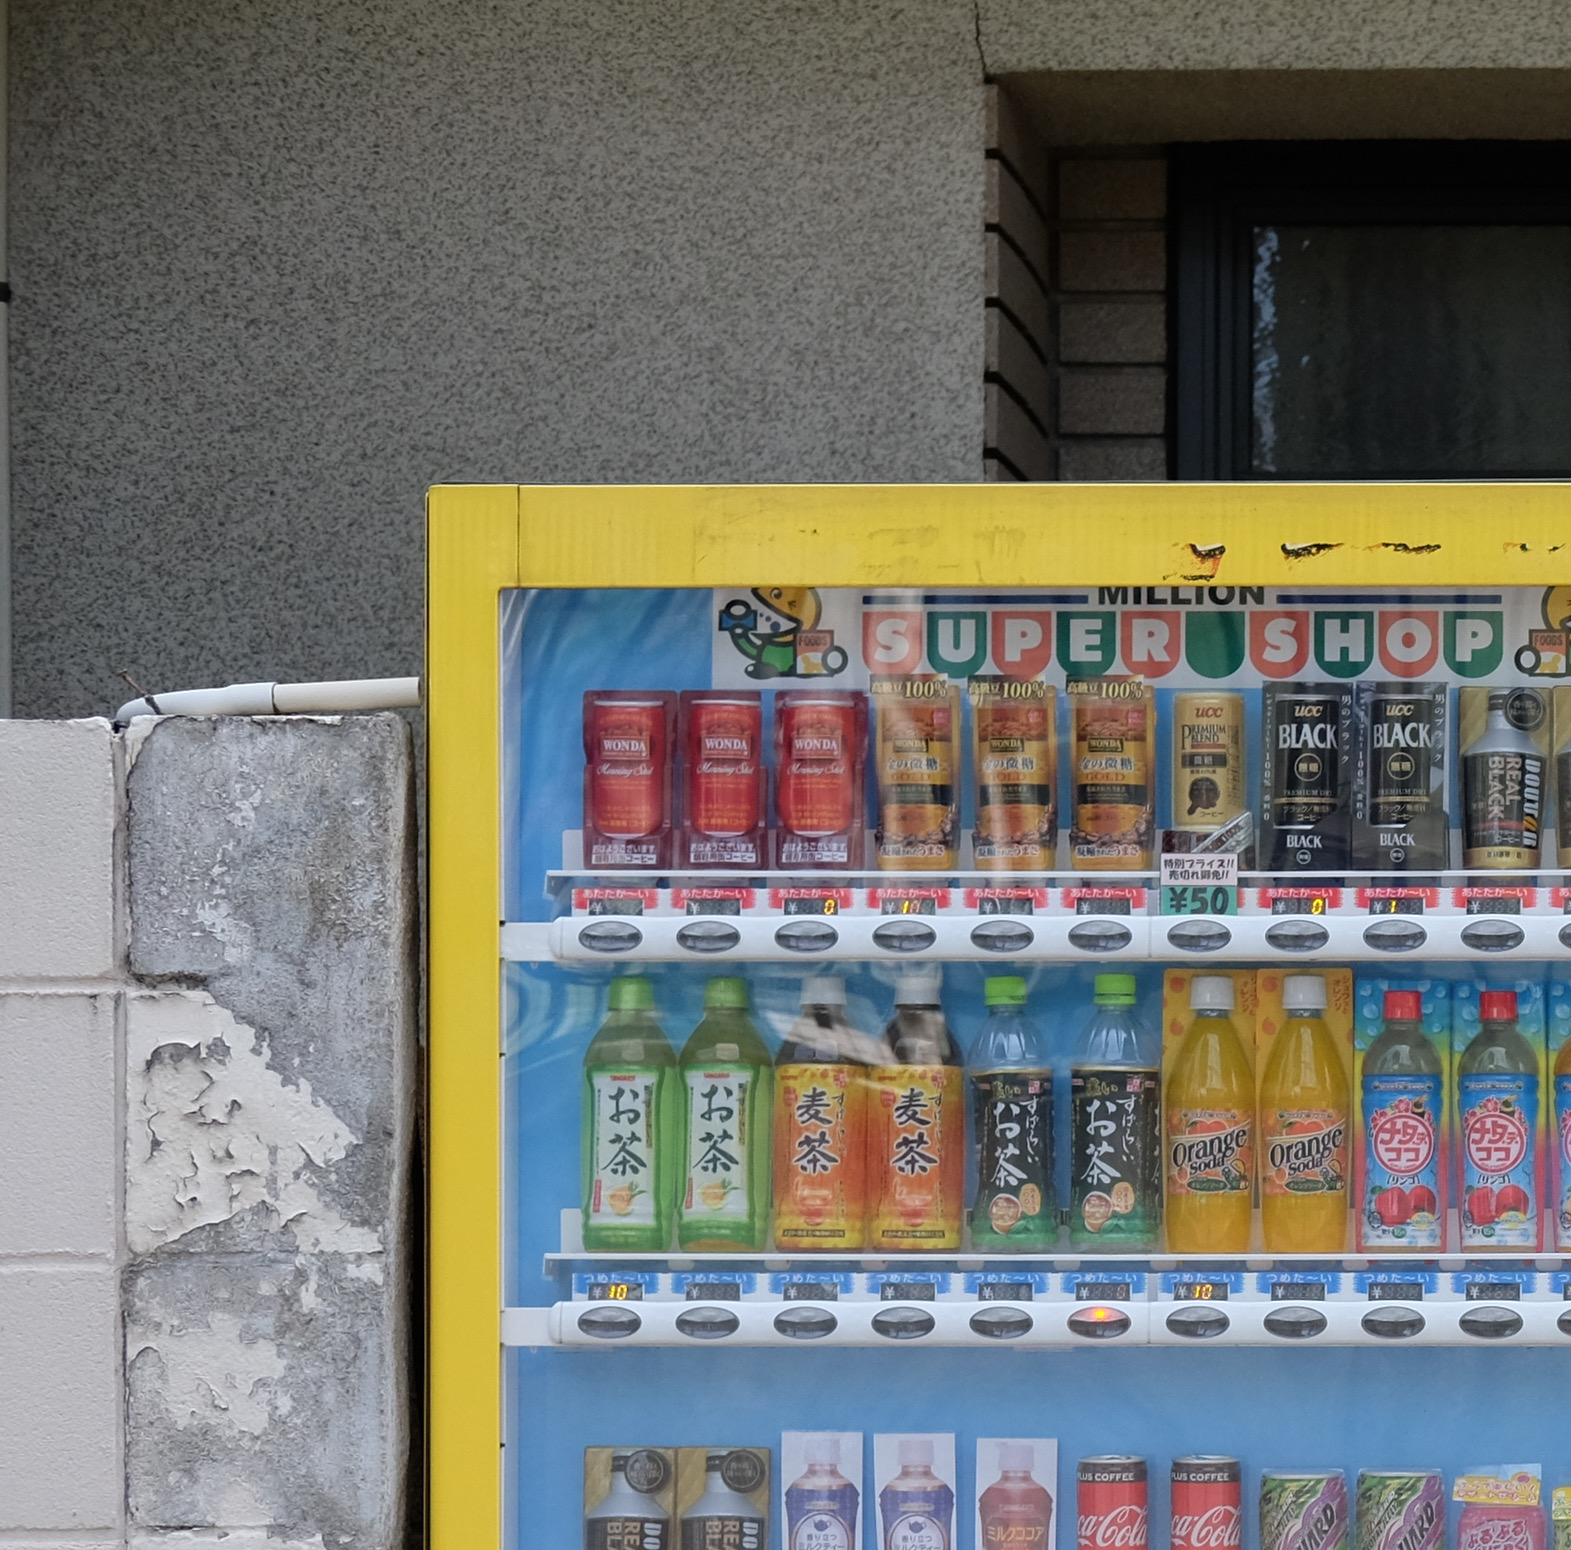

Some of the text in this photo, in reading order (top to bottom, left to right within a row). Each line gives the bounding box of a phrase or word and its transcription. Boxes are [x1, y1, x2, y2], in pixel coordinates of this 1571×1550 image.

[1098, 586, 1264, 605] MILLION
[873, 617, 1494, 664] SUPER SHOP
[1533, 634, 1563, 646] FOODS
[603, 739, 646, 751] WONDA
[705, 738, 747, 750] WONDA
[795, 739, 837, 750] WONDA
[895, 739, 927, 751] WONDA
[990, 739, 1022, 751] WONDA
[1089, 739, 1123, 751] WONDA
[1192, 733, 1220, 743] BLEND
[1279, 723, 1338, 748] BLACK
[1373, 723, 1433, 748] BLACK
[891, 773, 931, 782] GOLD
[988, 773, 1027, 782] GOLD
[1086, 773, 1125, 782] GOLD
[1506, 757, 1522, 805] REAL
[1489, 756, 1504, 820] BLACK
[1286, 835, 1322, 848] BLACK
[1380, 833, 1415, 846] BLACK
[1169, 887, 1229, 915] ¥50
[601, 1085, 647, 1176] お茶
[693, 1084, 739, 1174] お茶
[794, 1087, 839, 1174] 麦茶
[892, 1088, 938, 1175] 麦茶
[991, 1101, 1028, 1187] お茶
[1081, 1099, 1121, 1185] お茶
[1173, 1129, 1246, 1168] Orange
[1270, 1129, 1342, 1168] Orange
[1190, 1155, 1225, 1176] soda
[1288, 1156, 1322, 1176] soda
[1078, 1472, 1134, 1482] LUS COFFEE
[1189, 1473, 1229, 1481] COFFEE
[987, 1526, 1045, 1542] ミルクココア
